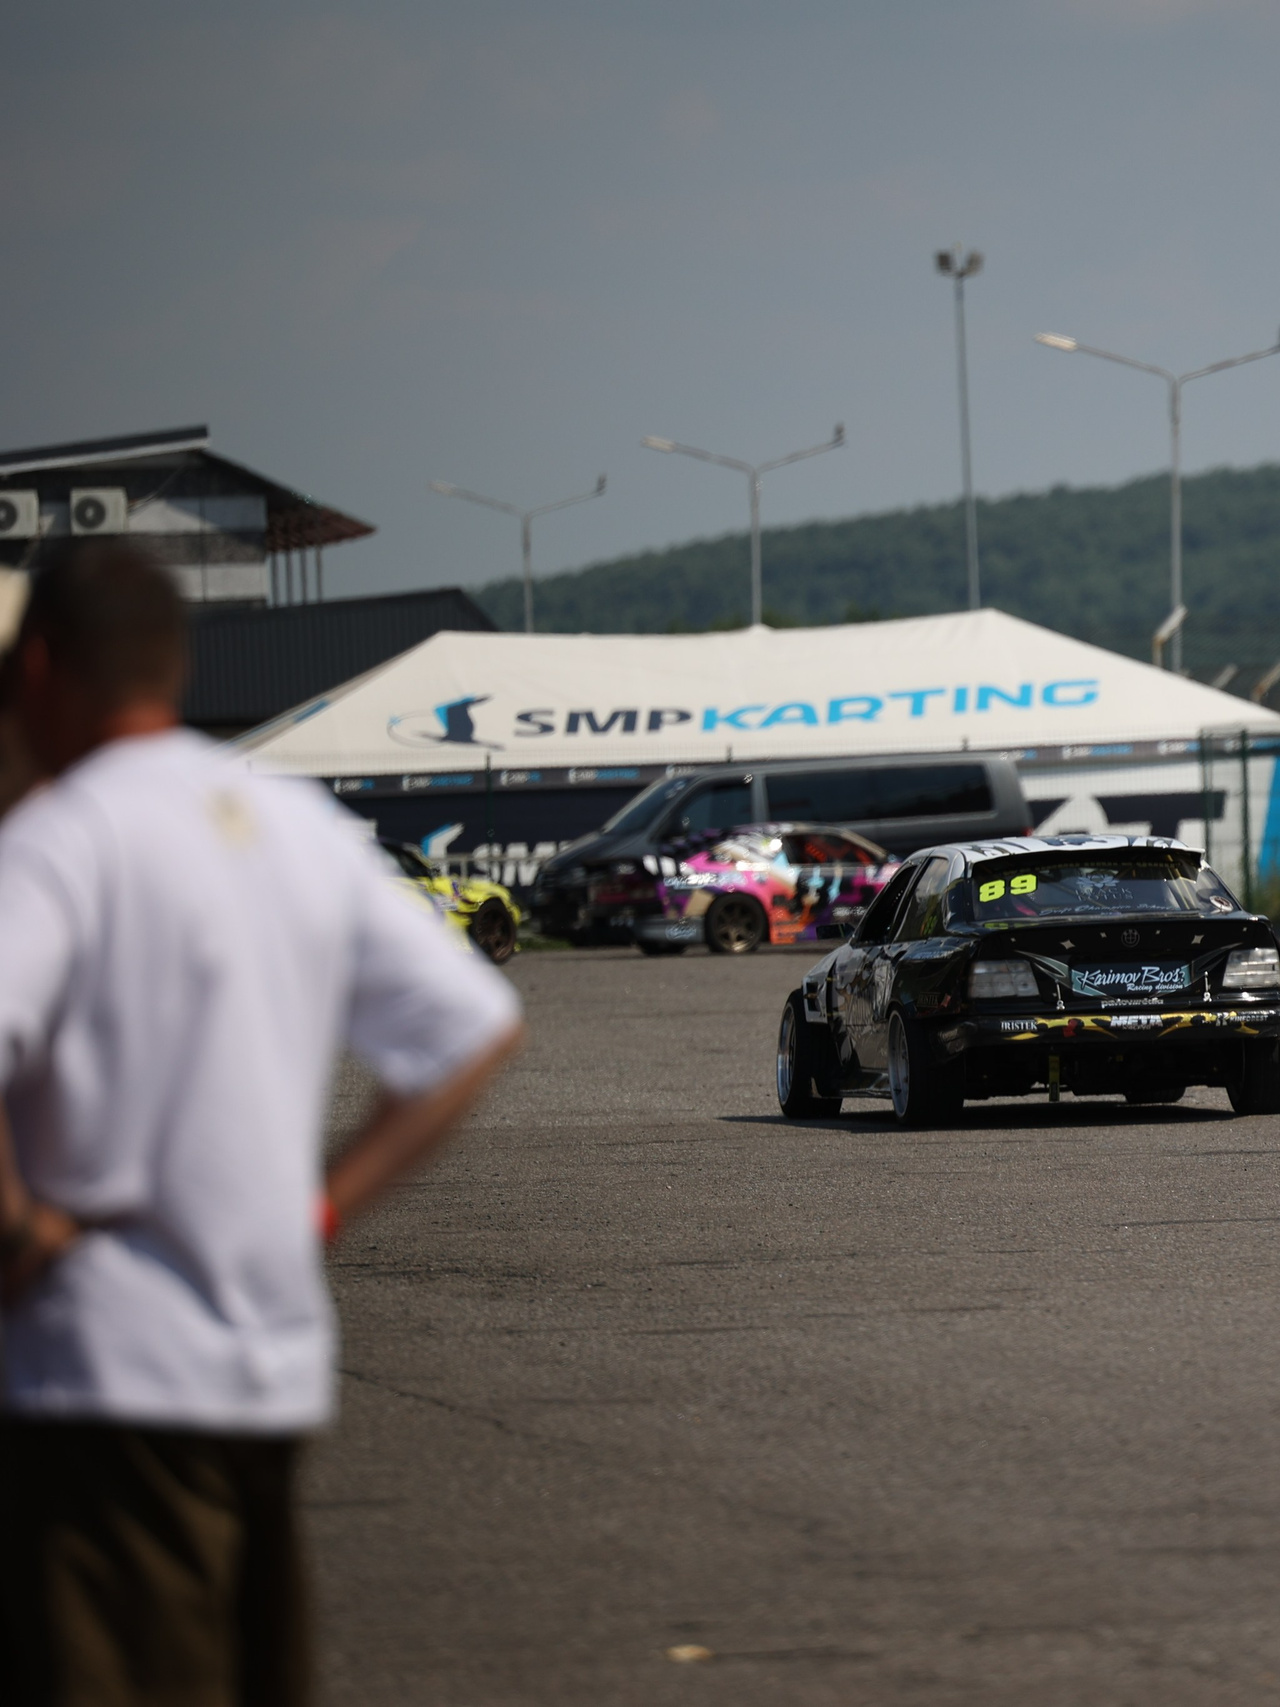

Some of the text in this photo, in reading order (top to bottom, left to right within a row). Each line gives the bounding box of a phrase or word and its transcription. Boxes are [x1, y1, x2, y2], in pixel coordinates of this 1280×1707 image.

[471, 841, 572, 886] SM
[979, 873, 1038, 903] 89
[1079, 969, 1141, 988] Karimov
[1126, 983, 1154, 992] Racing
[1110, 1014, 1163, 1027] META
